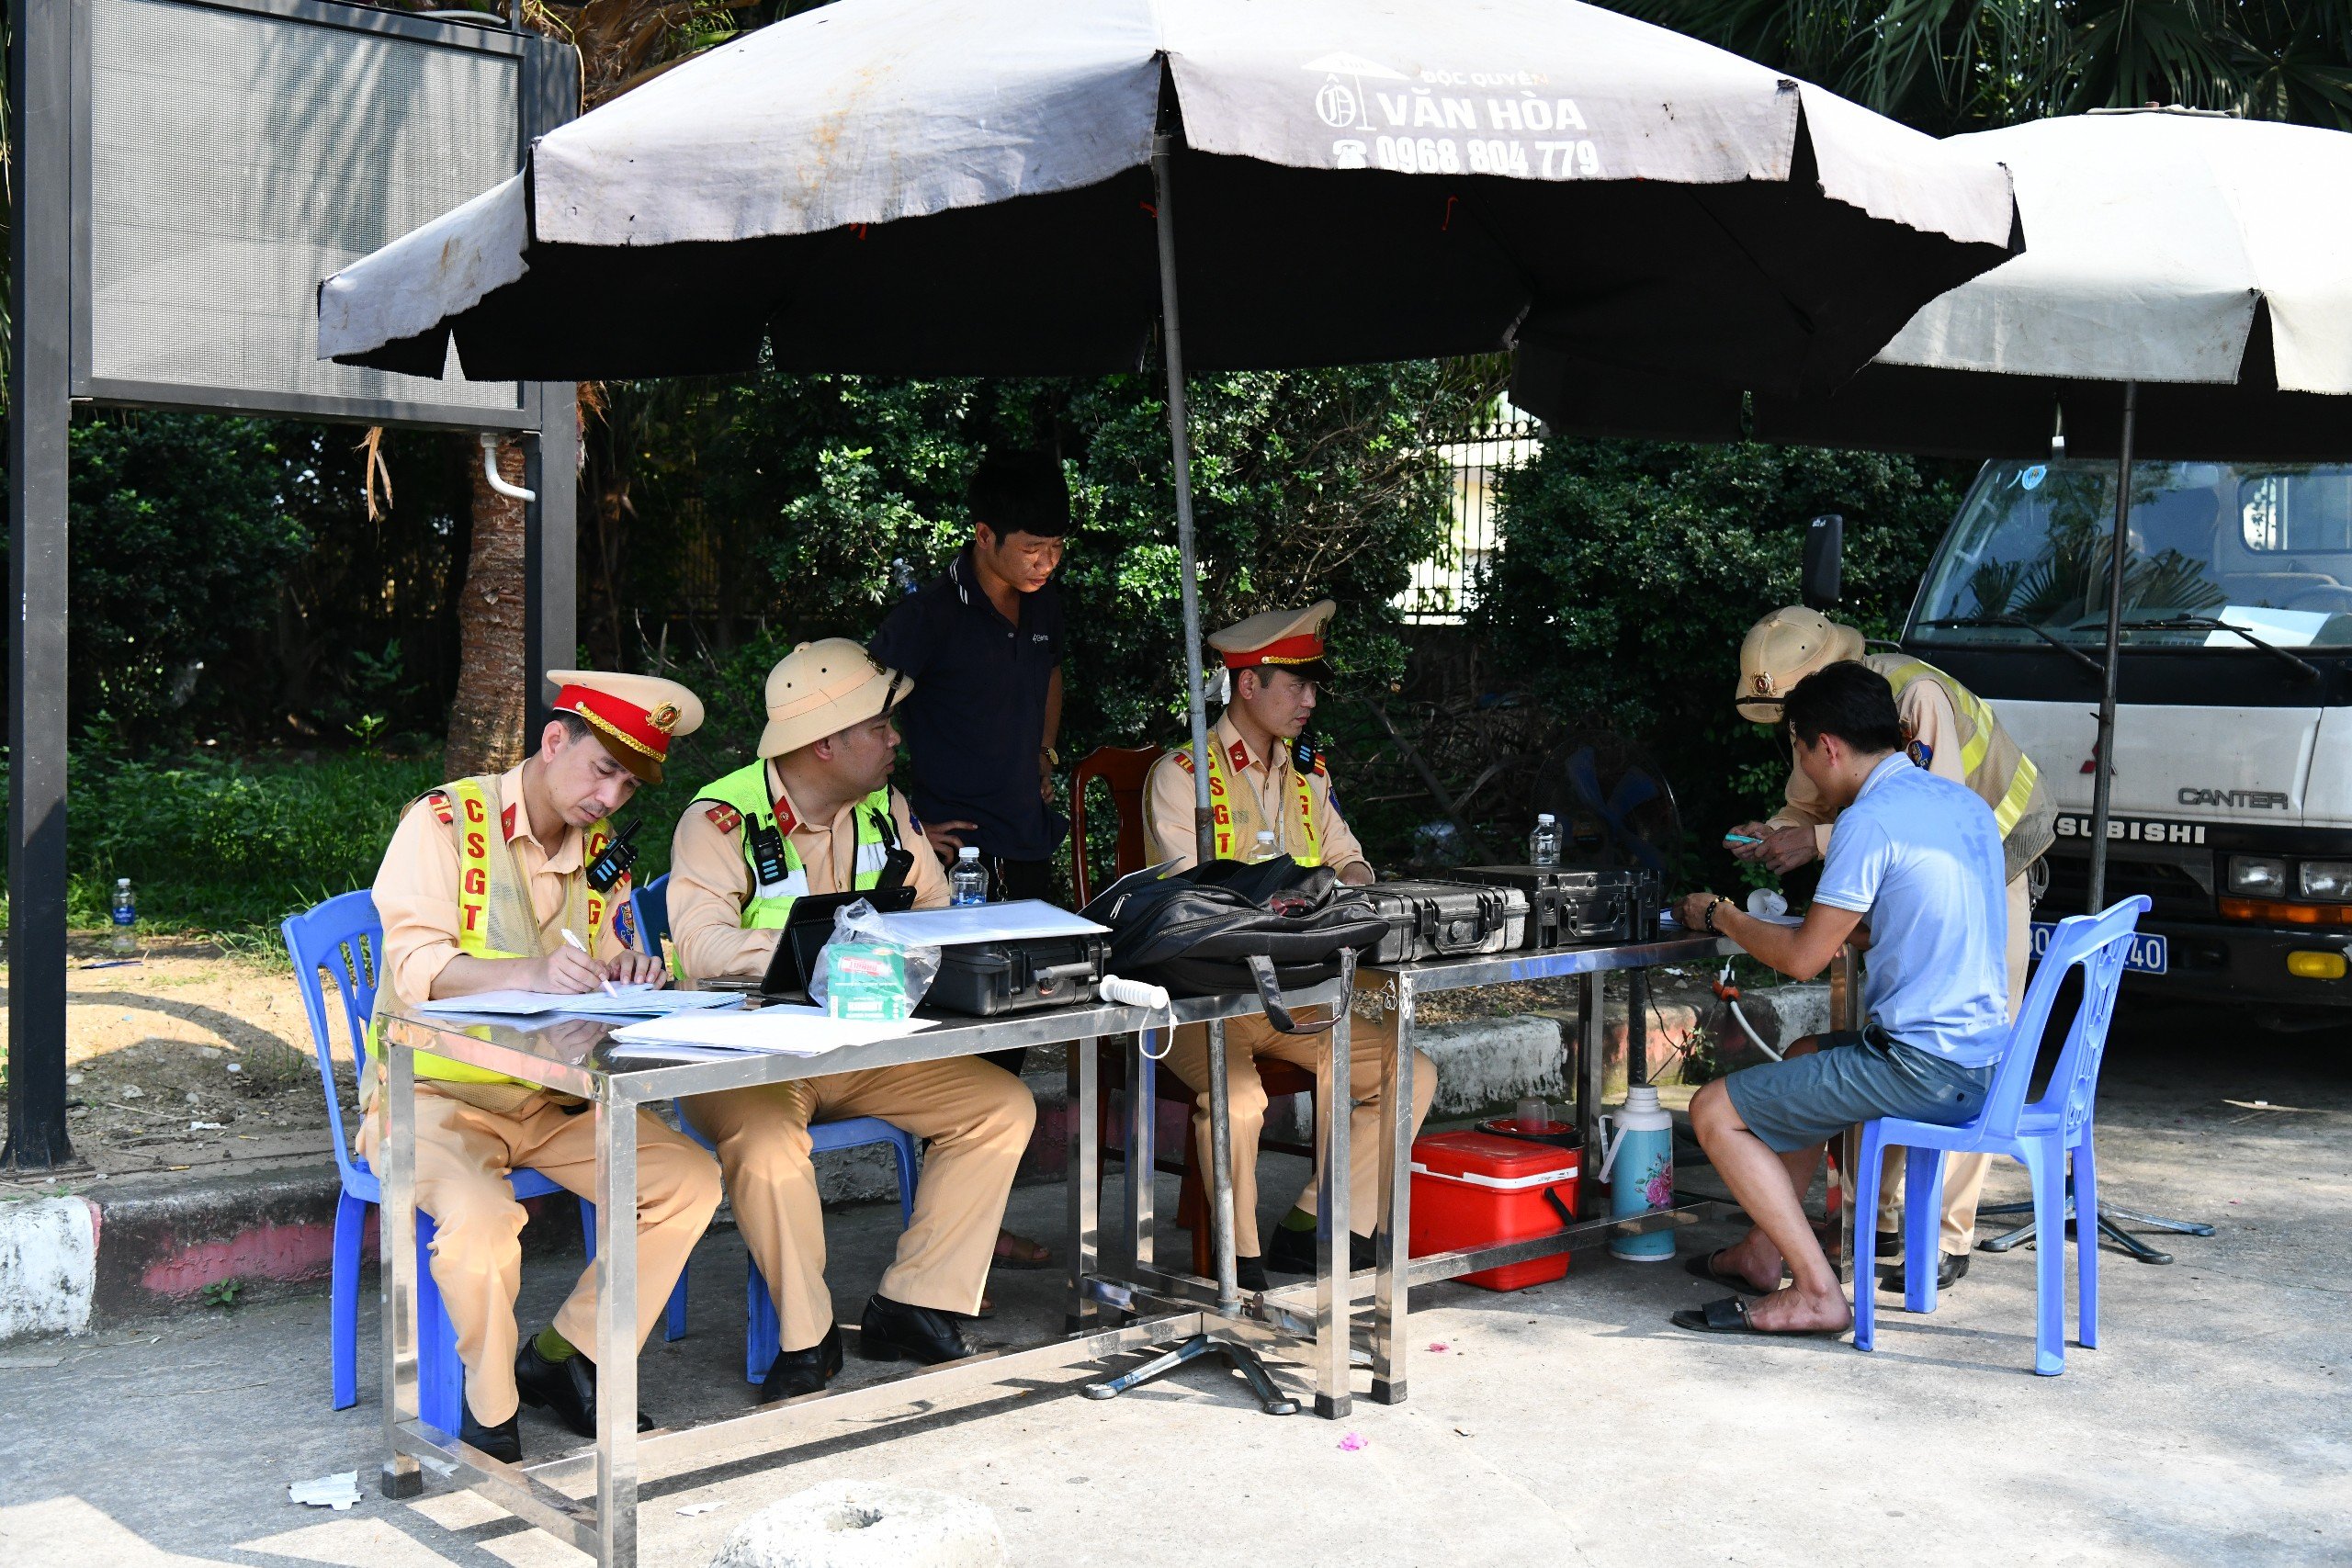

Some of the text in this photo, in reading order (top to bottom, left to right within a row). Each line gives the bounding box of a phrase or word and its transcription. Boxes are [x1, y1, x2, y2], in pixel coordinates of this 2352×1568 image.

[1376, 87, 1588, 130] VĂN HÒA
[1376, 136, 1600, 177] 0968 804 779
[2177, 787, 2289, 810] CANTER
[464, 798, 486, 931] CSGT
